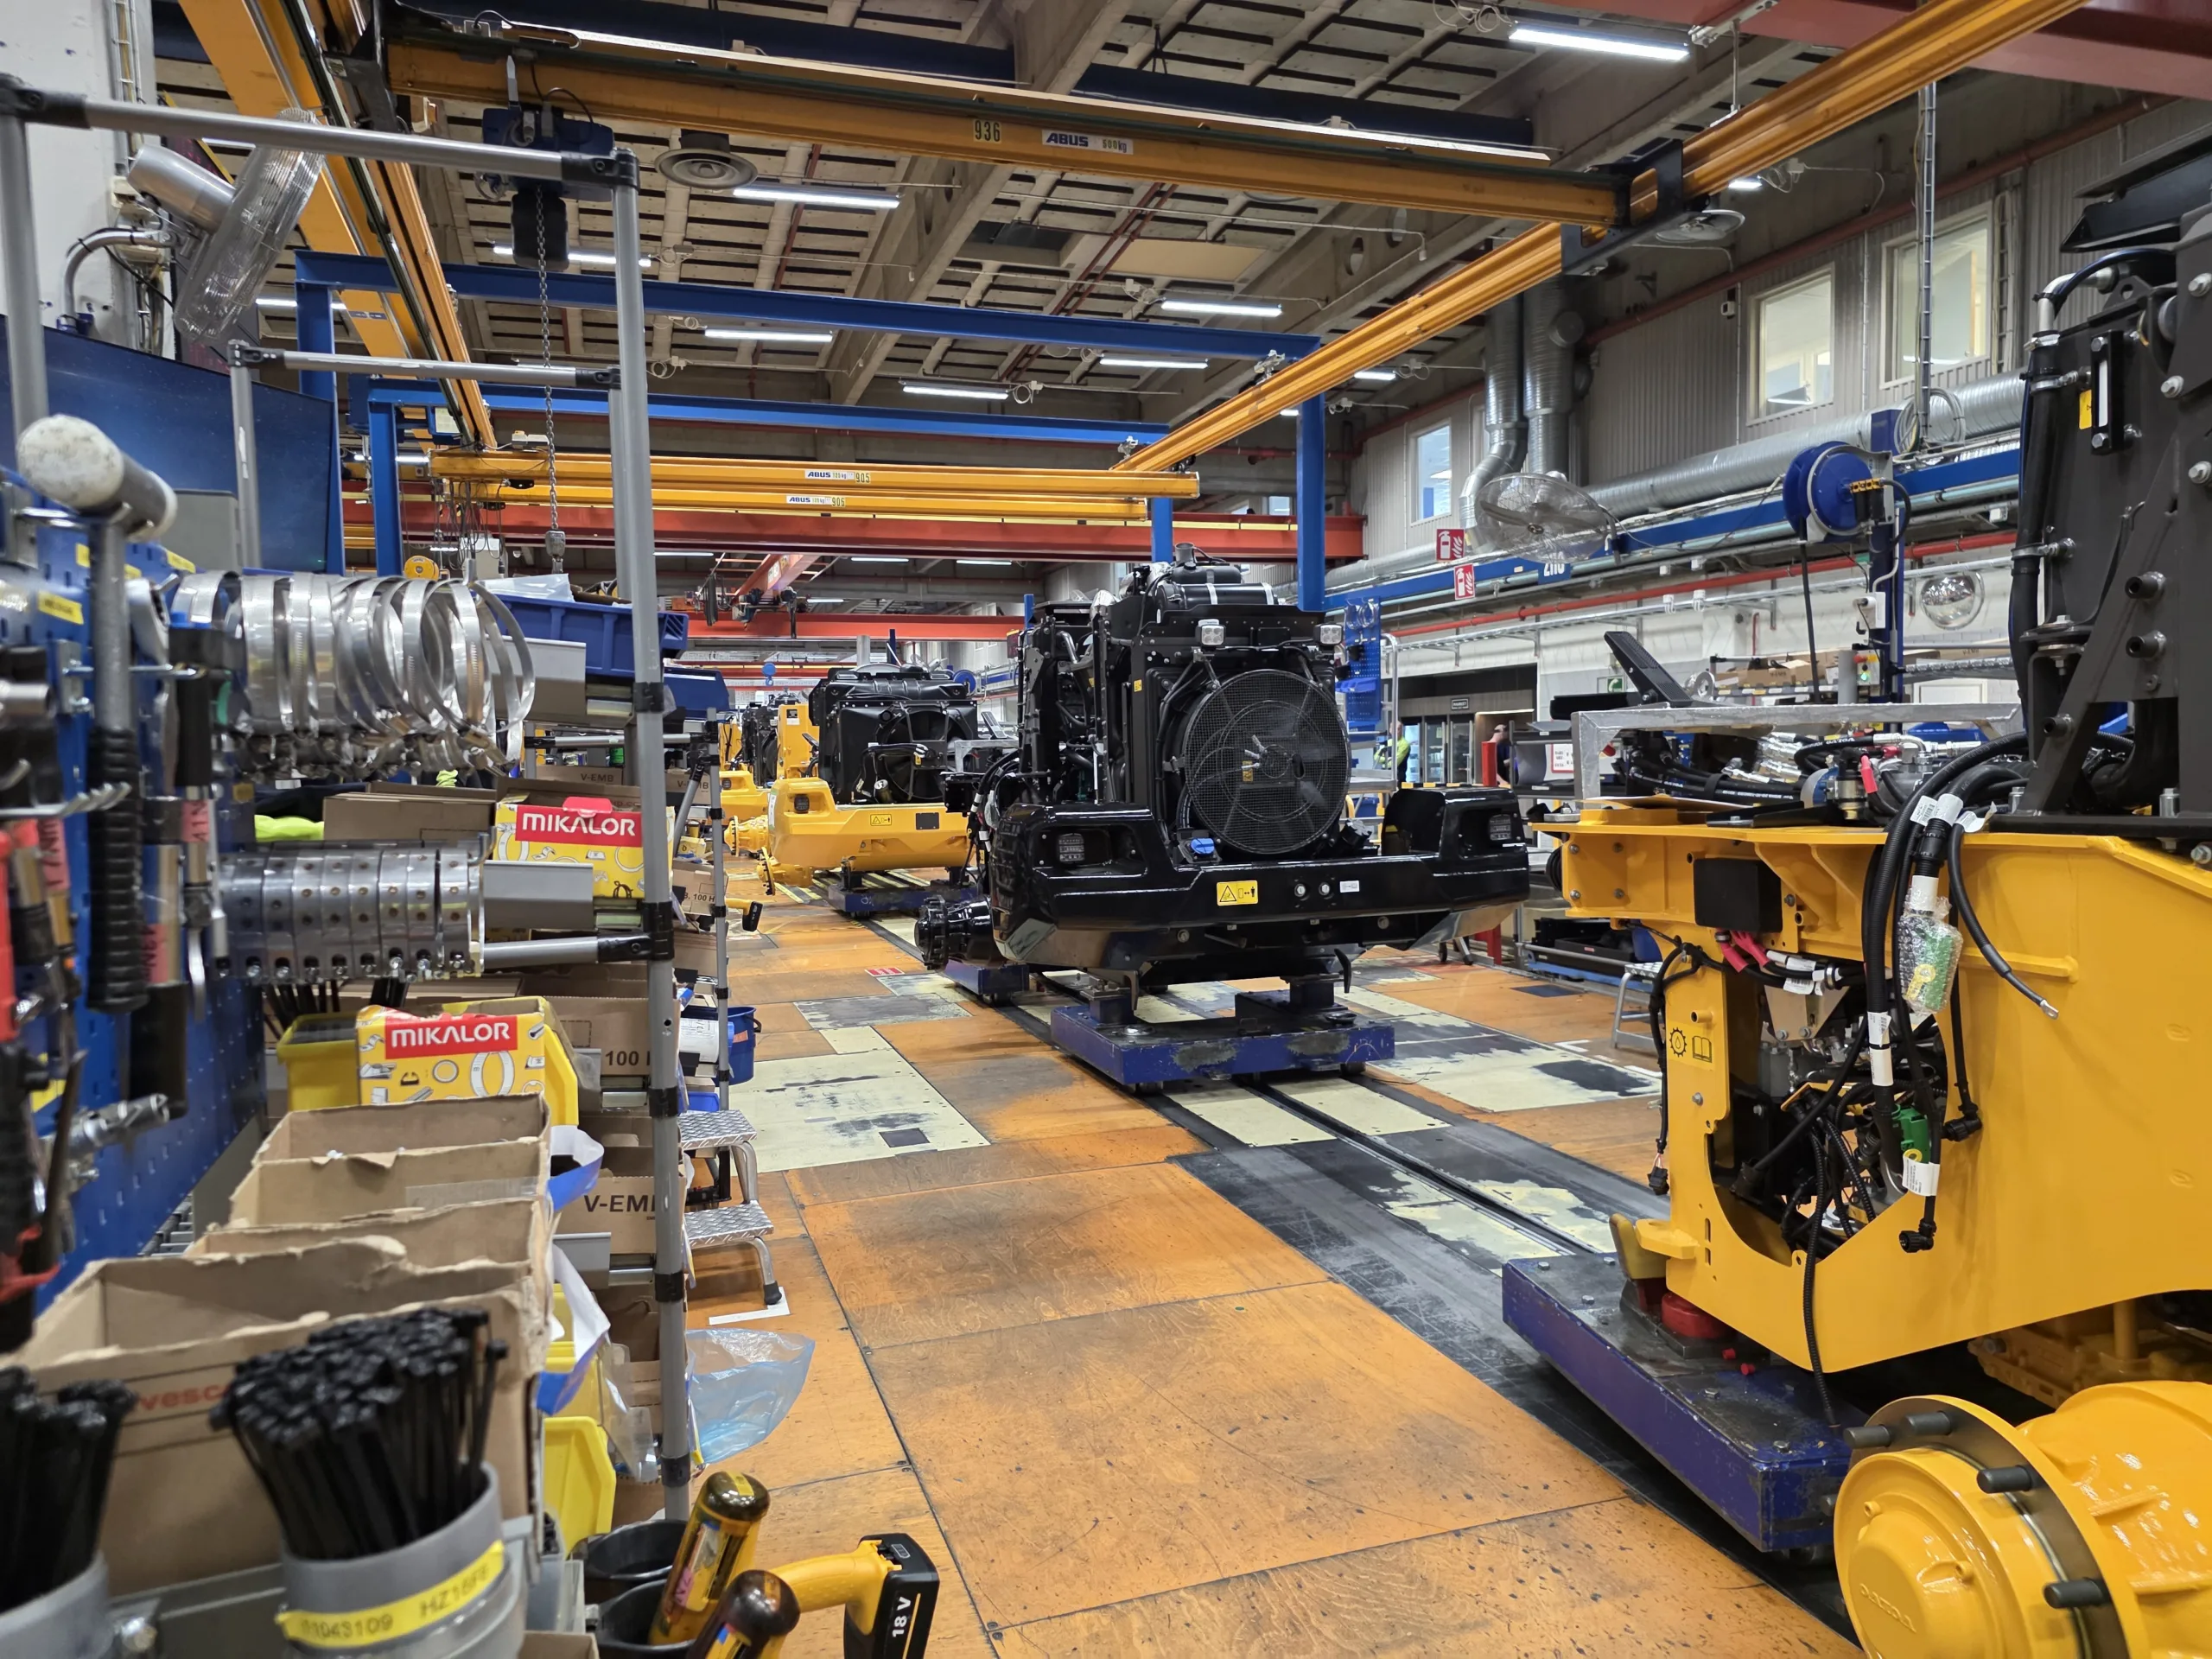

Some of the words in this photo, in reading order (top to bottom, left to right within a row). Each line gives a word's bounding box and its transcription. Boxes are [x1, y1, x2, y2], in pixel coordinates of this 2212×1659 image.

[974, 120, 1001, 142] 936
[1046, 132, 1089, 148] ABUS
[855, 473, 870, 483] 905
[832, 497, 845, 507] 906
[581, 772, 614, 783] V-EMB
[522, 812, 636, 836] MIKALOR
[391, 1022, 510, 1048] MIKALOR
[605, 1050, 639, 1066] 100
[896, 1596, 912, 1611] V
[892, 1615, 908, 1637] 18
